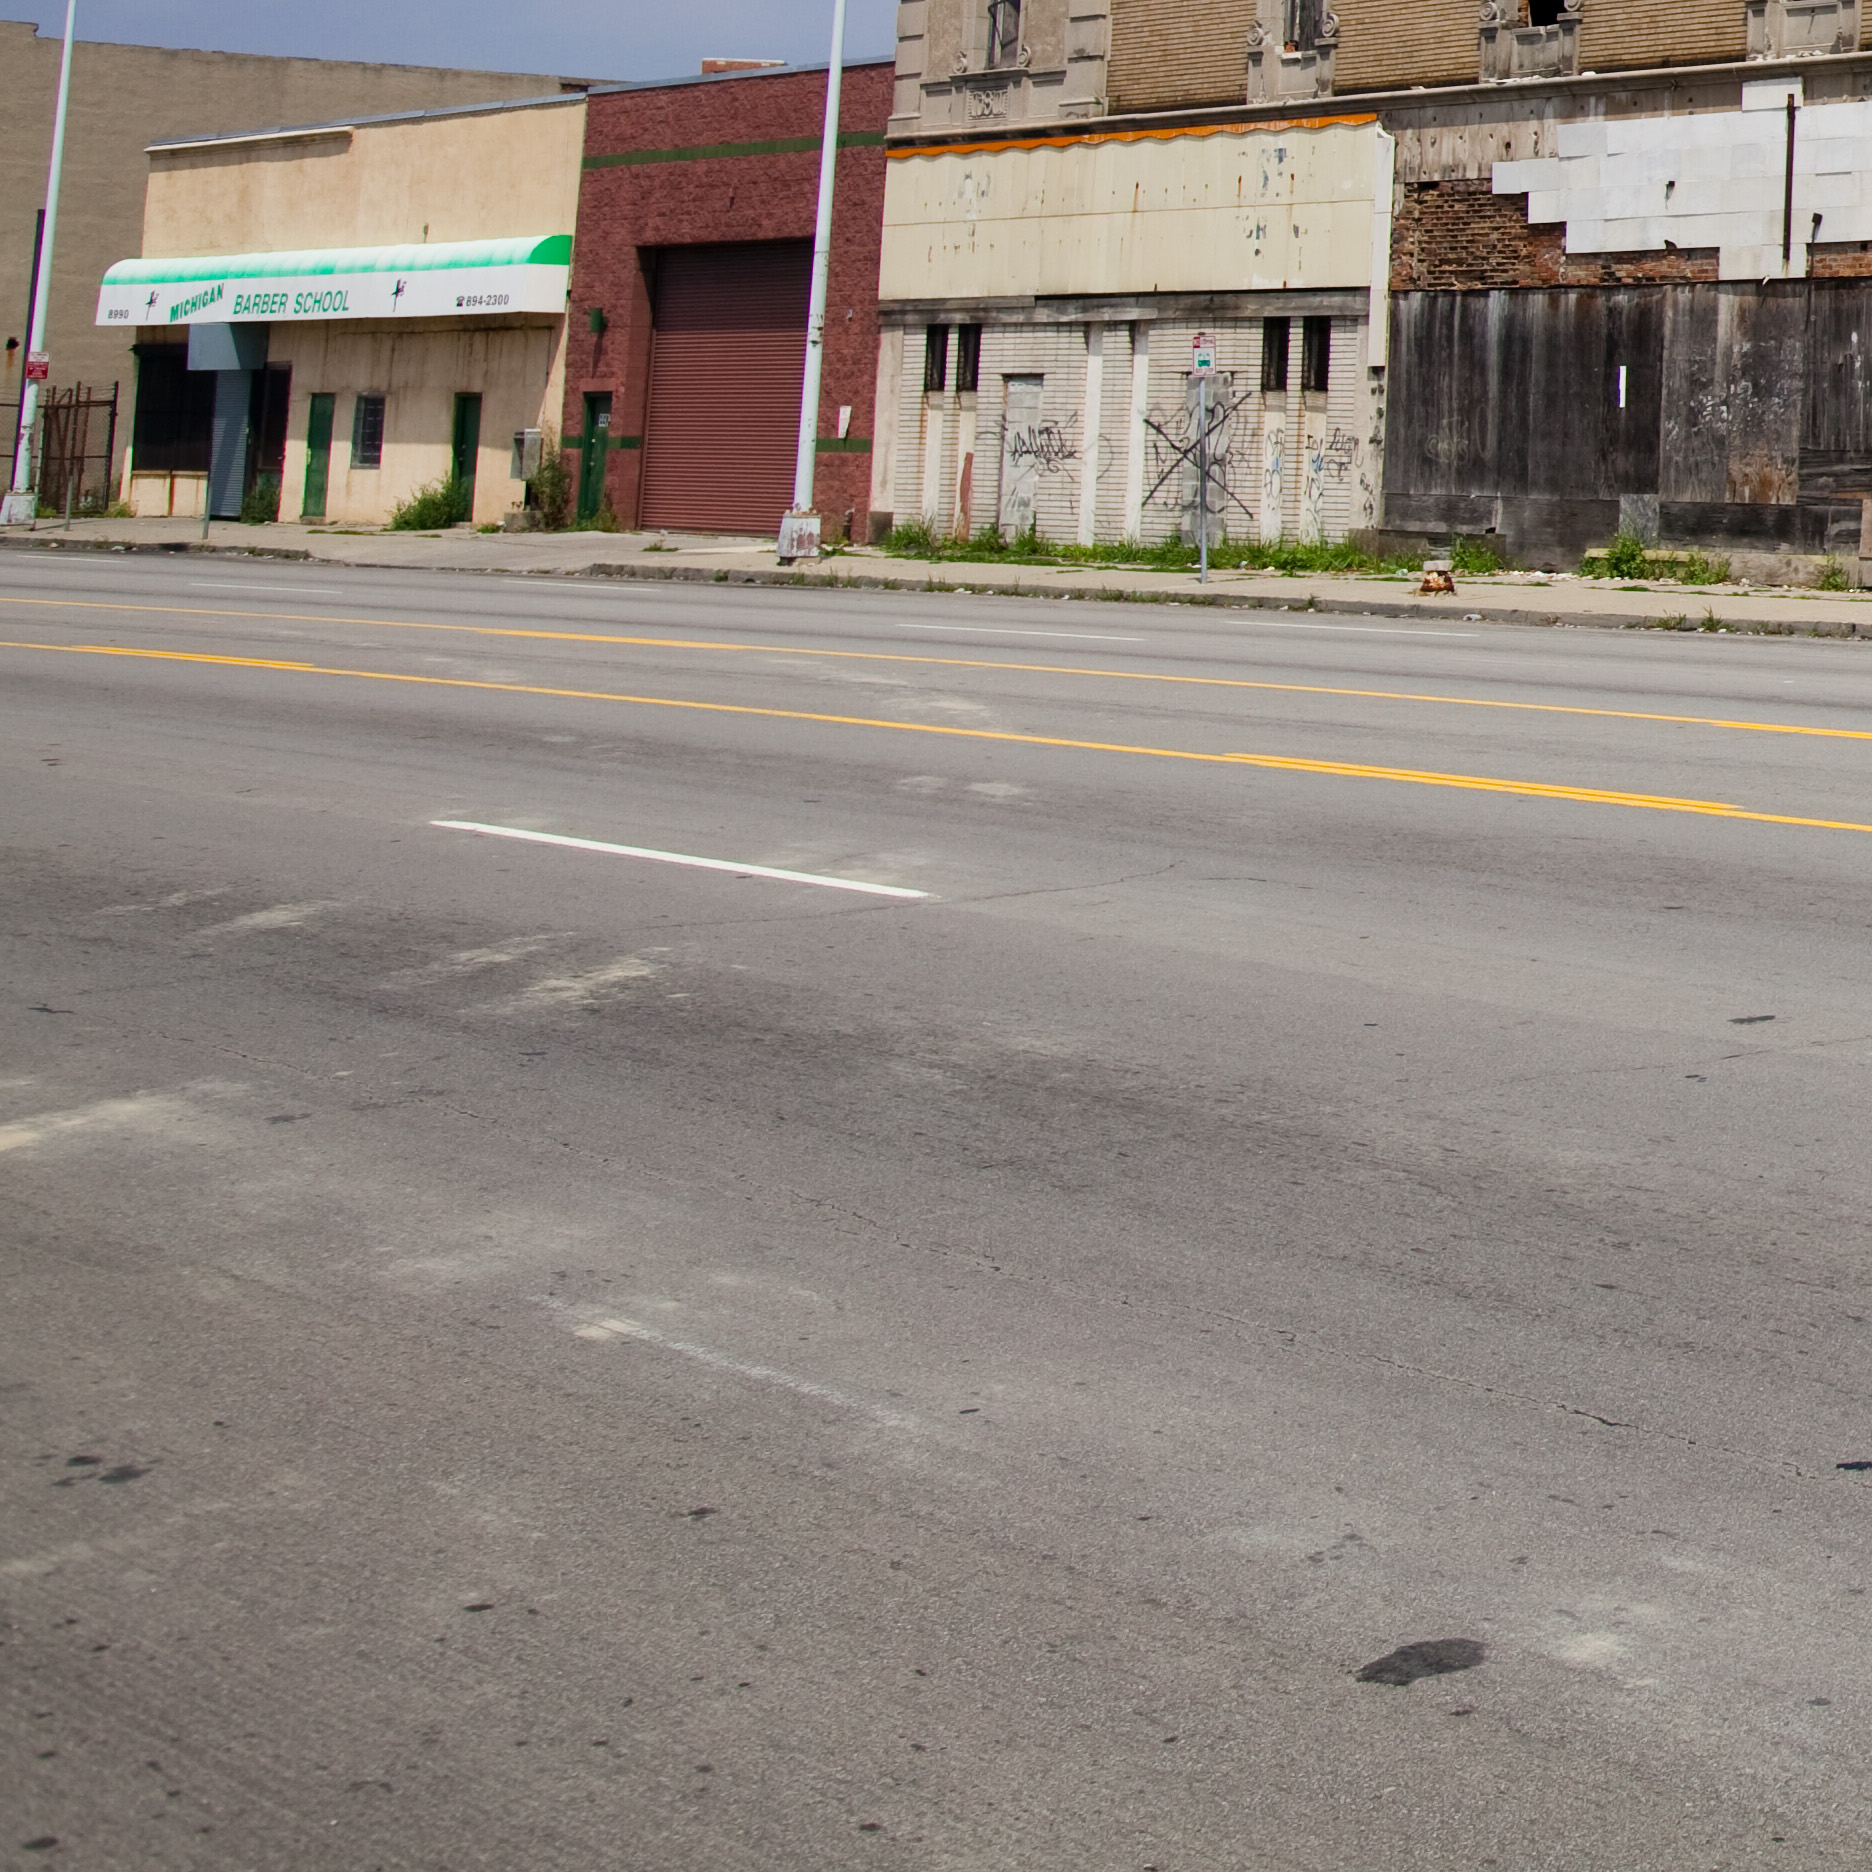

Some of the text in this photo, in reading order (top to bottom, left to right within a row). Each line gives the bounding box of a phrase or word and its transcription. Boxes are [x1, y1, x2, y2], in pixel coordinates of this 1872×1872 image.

[169, 282, 349, 323] MICHIGAN BARBER SCHOOL
[465, 294, 510, 307] 894-2300
[107, 309, 129, 319] 8990
